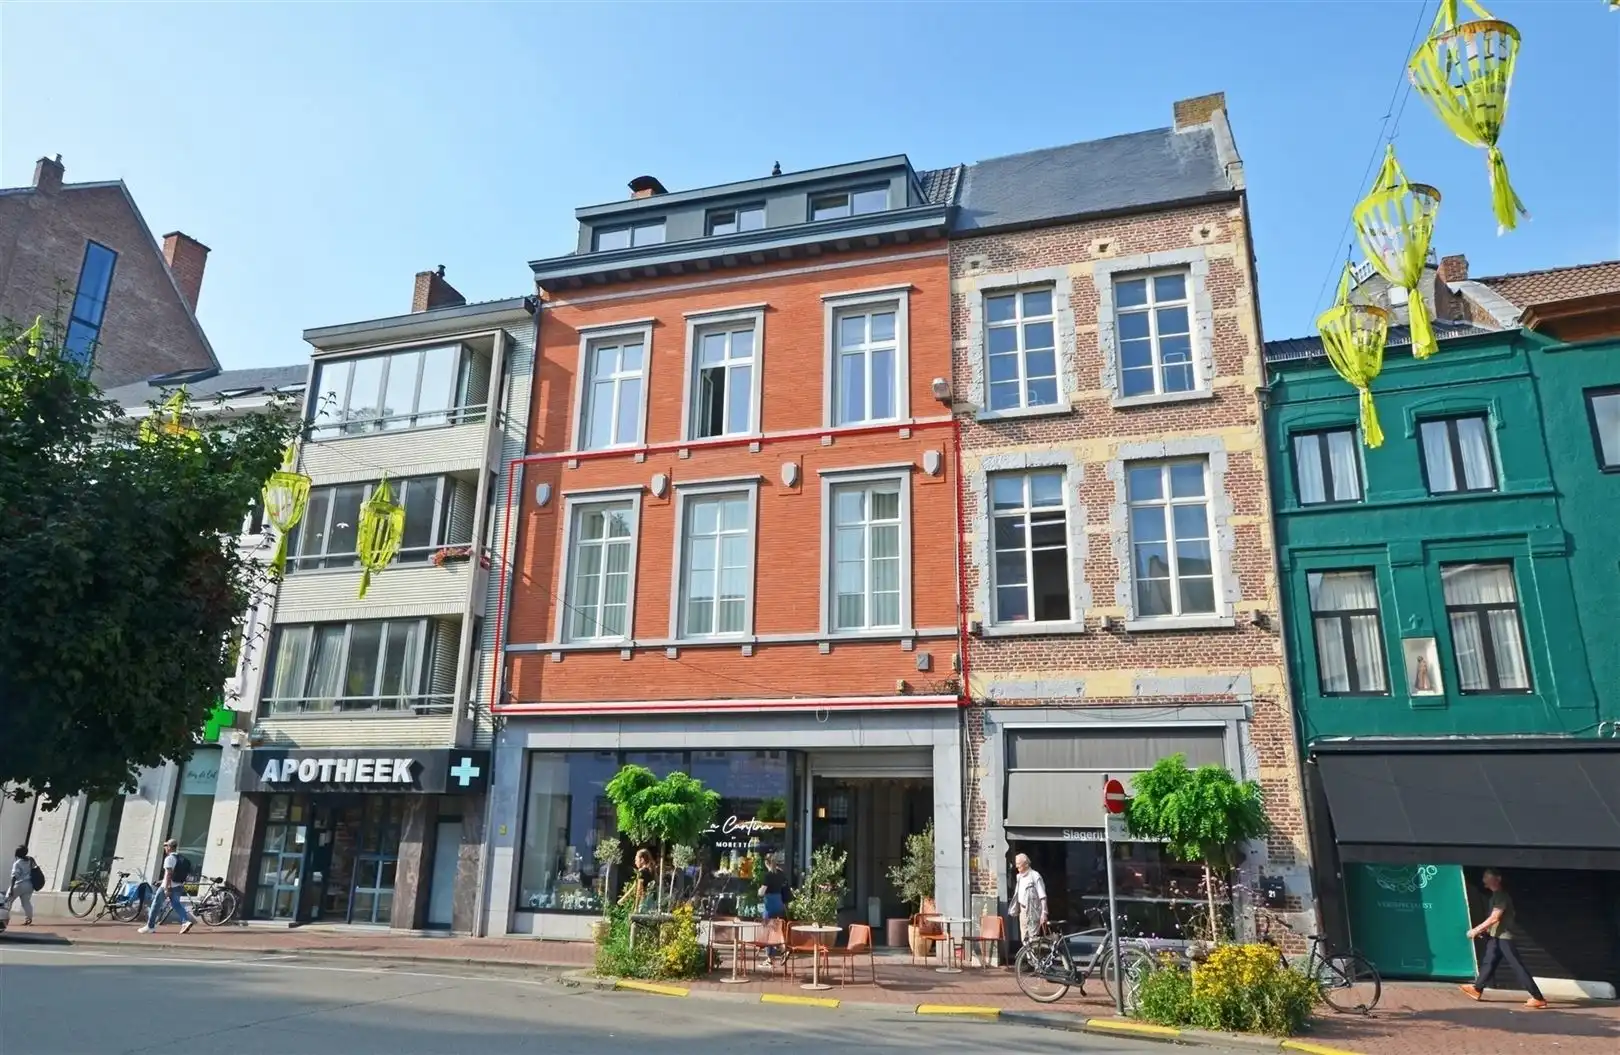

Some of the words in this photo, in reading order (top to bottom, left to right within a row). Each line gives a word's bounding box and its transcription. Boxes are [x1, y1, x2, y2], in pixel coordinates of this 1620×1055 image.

[260, 758, 413, 783] APOTHEEK
[722, 815, 774, 836] Cantina
[1268, 890, 1276, 898] 21
